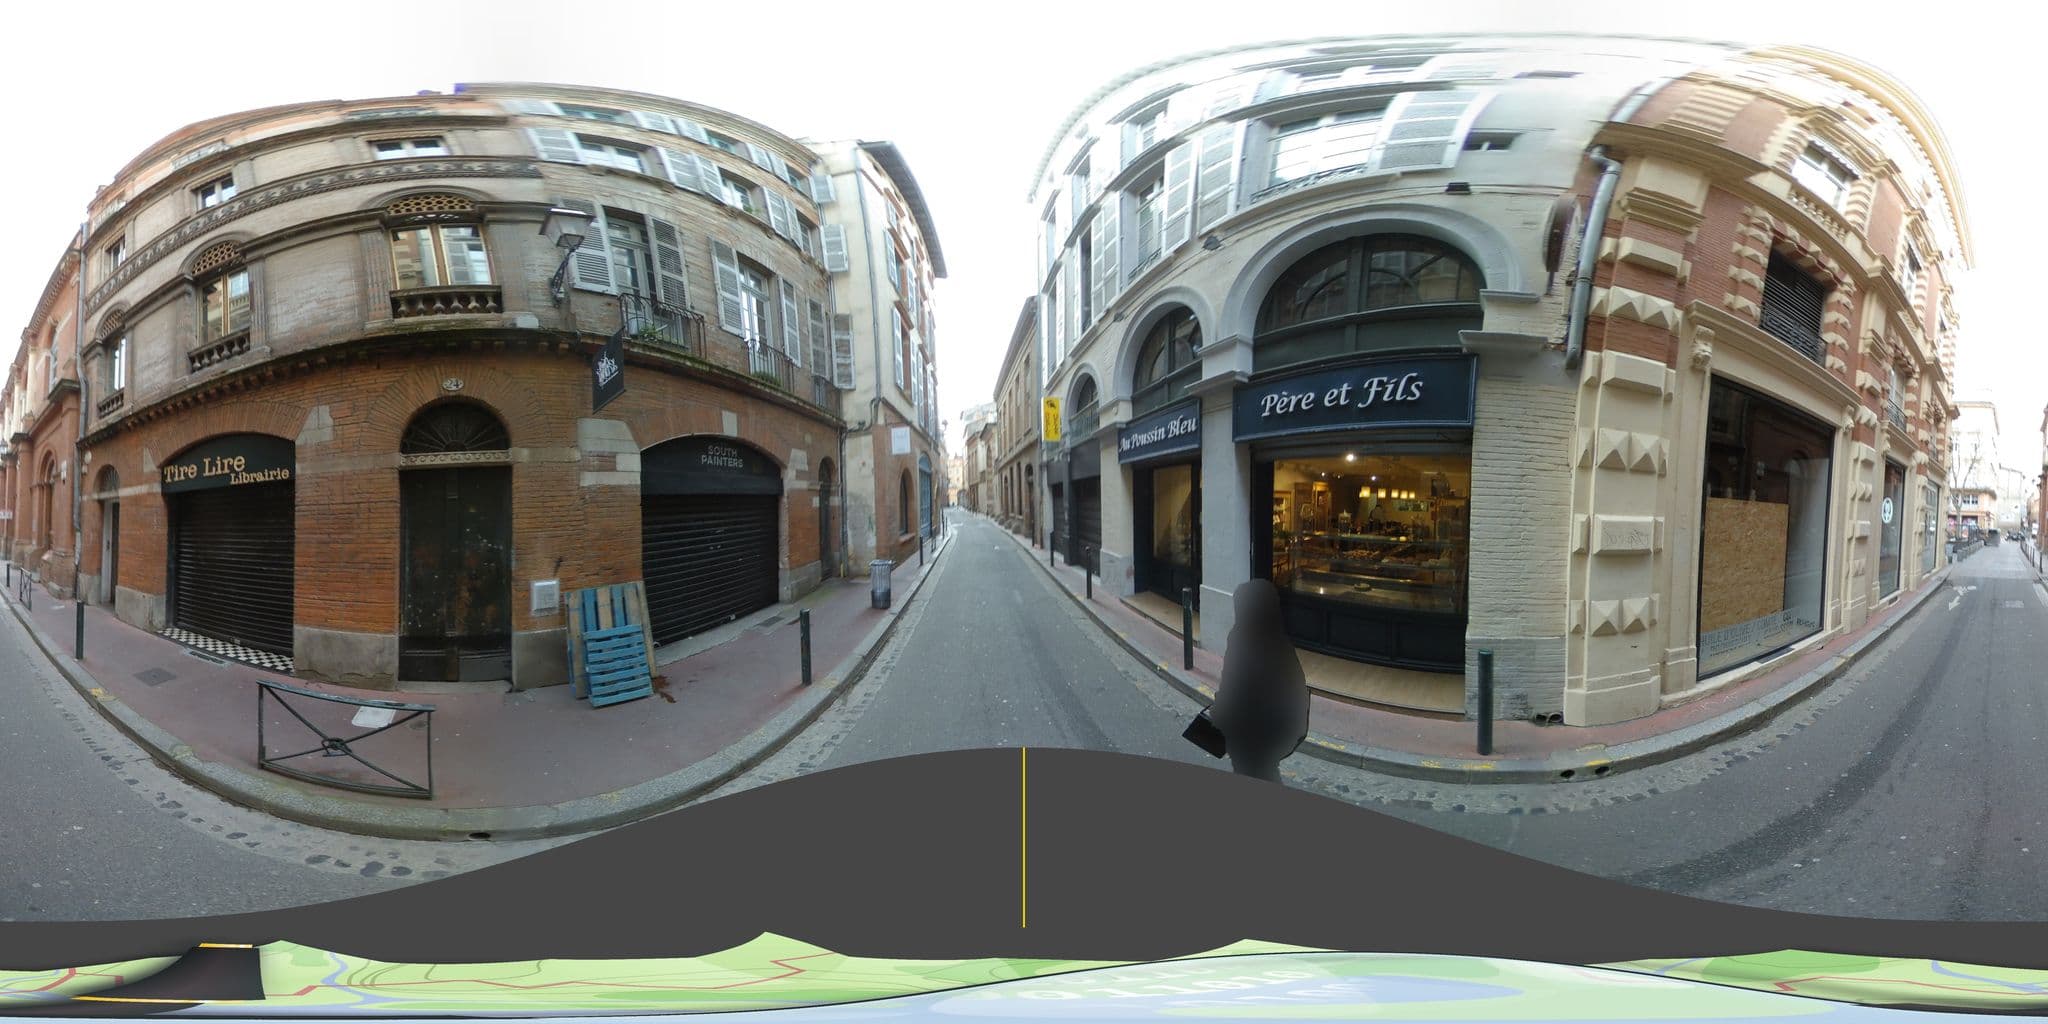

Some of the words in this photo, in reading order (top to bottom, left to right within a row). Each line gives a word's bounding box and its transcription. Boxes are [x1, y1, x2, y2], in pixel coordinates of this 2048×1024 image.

[446, 378, 460, 389] 24
[1261, 391, 1314, 417] Père
[1323, 382, 1353, 407] et
[1357, 372, 1424, 408] Fils
[1119, 437, 1131, 452] Au
[1130, 425, 1166, 449] Poussin
[1168, 415, 1197, 438] Bleu
[707, 445, 738, 457] SOUTH
[164, 463, 198, 483] Tire
[203, 455, 246, 477] Lire
[701, 455, 744, 468] PAINTERS
[230, 468, 290, 485] Librairie
